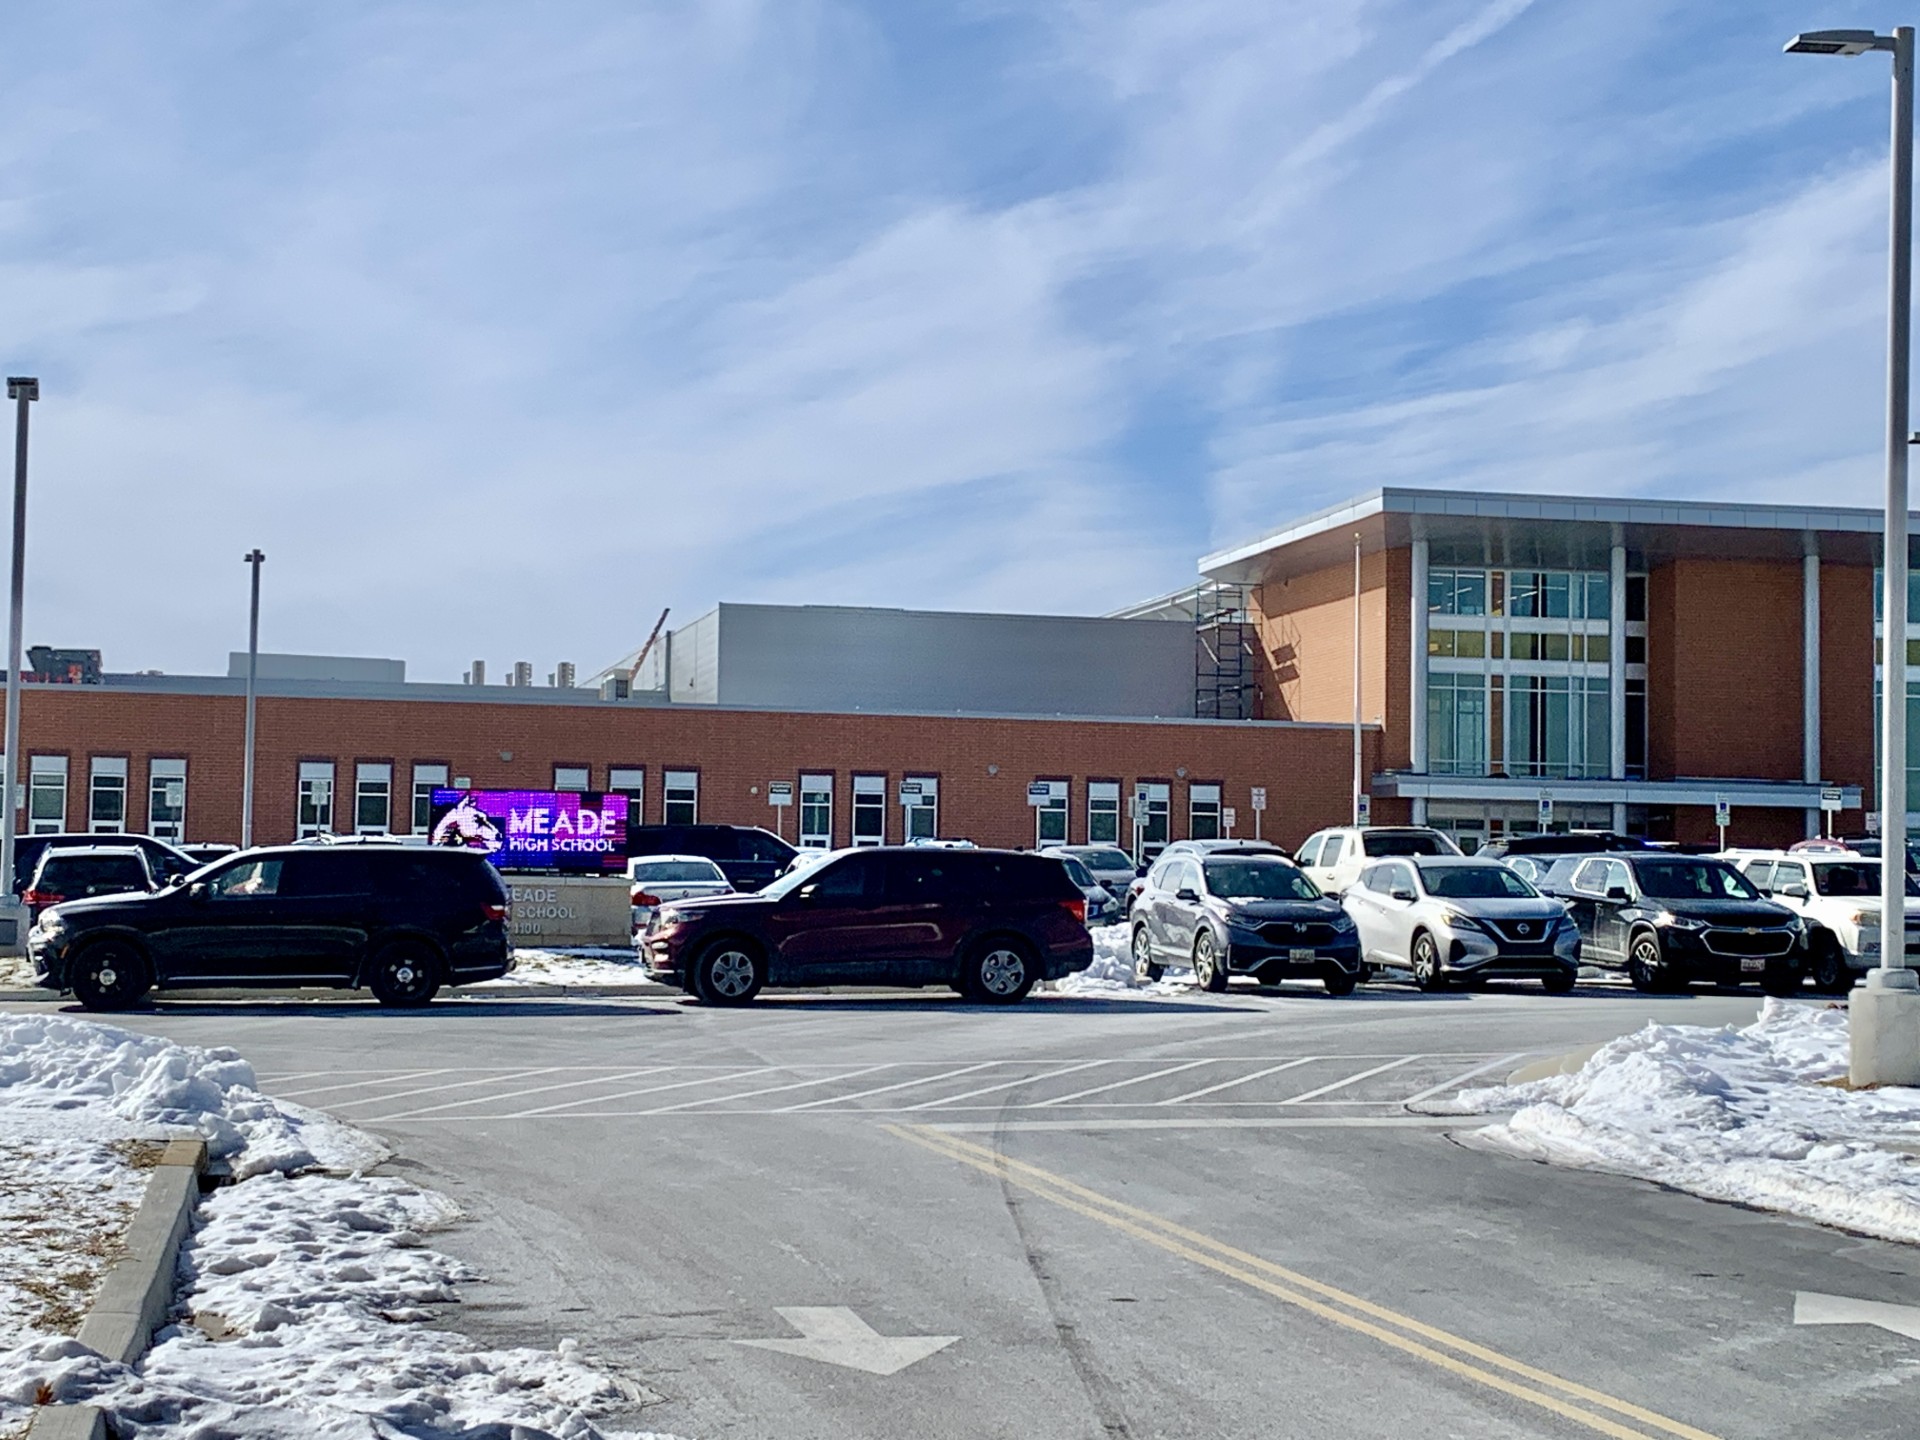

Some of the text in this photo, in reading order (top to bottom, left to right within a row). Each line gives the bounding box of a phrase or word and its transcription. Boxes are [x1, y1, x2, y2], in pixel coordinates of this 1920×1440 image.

[509, 808, 616, 835] MEADE
[509, 838, 615, 852] HIGH SCHOOL
[511, 888, 557, 903] EADE
[517, 906, 576, 919] SCHOOL
